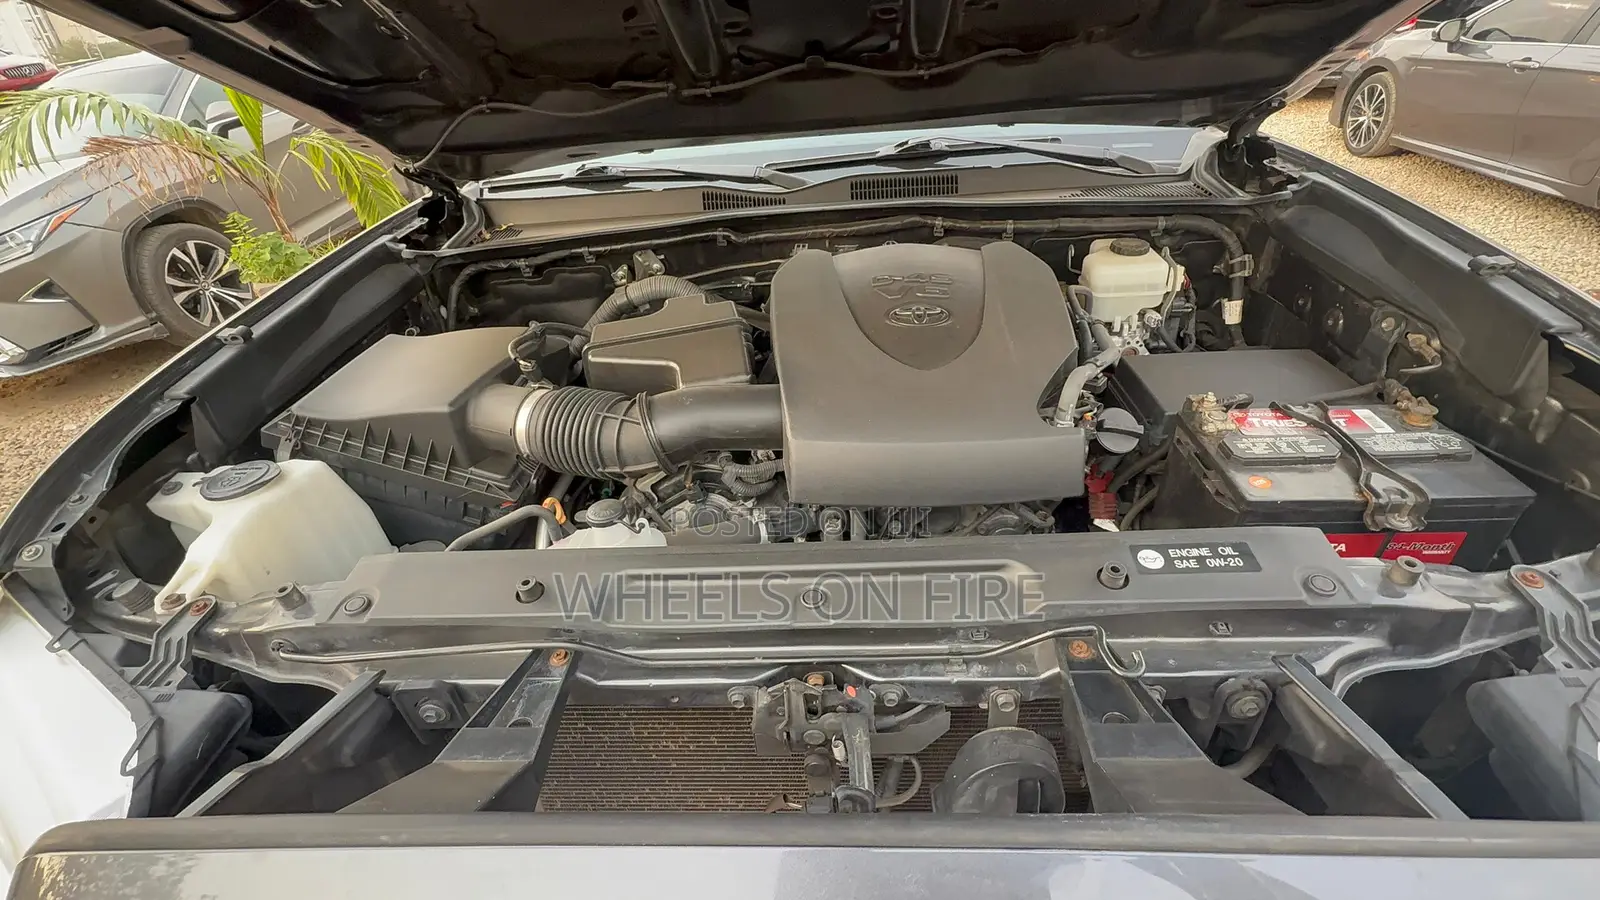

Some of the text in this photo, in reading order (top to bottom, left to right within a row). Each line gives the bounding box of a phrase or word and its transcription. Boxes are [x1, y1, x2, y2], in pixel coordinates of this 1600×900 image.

[1168, 546, 1239, 558] ENGINE OIL
[1173, 557, 1244, 569] SAE 0W-20
